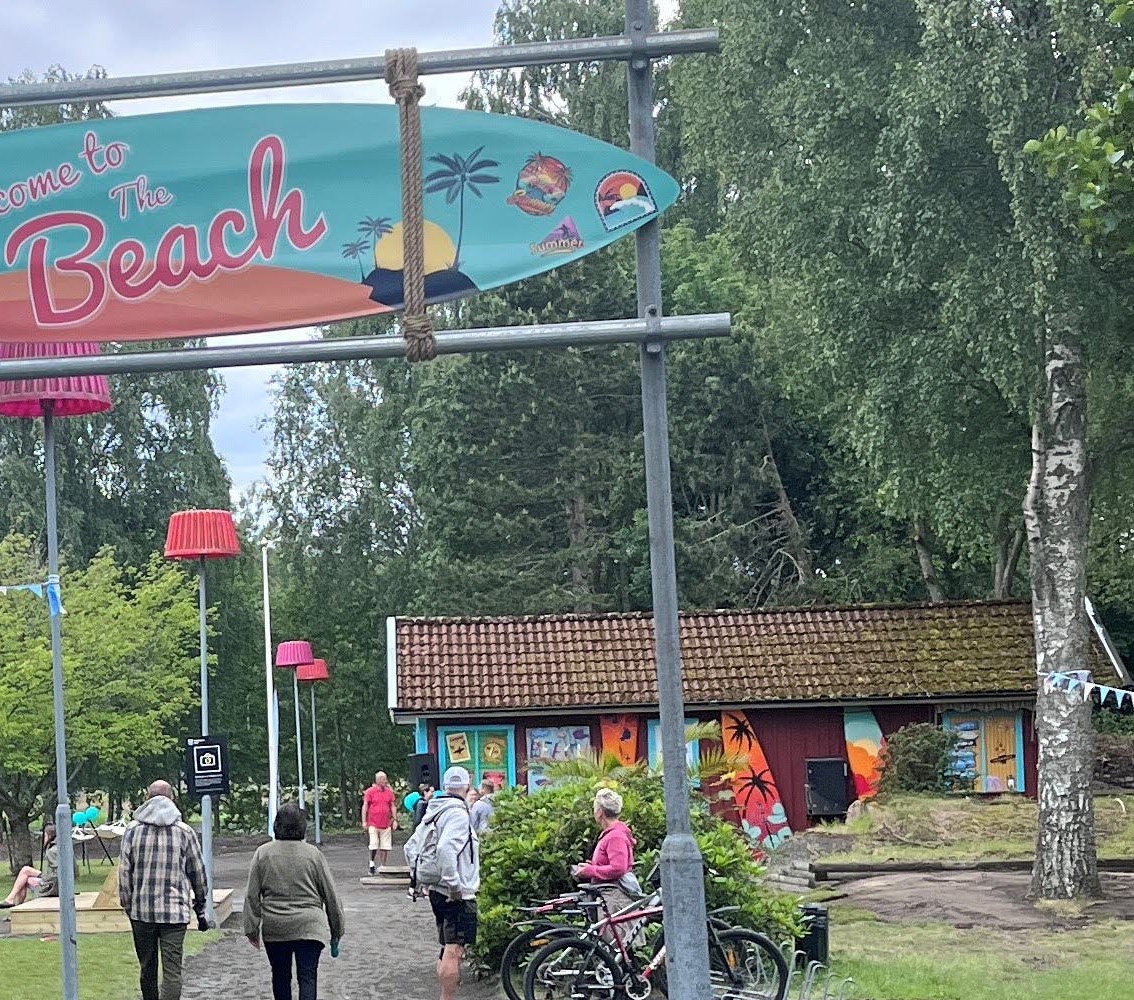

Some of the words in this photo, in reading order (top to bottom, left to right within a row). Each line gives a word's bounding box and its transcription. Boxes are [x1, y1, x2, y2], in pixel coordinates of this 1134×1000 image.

[78, 131, 130, 175] to
[109, 174, 173, 219] The
[4, 134, 328, 327] Beach
[529, 238, 584, 255] Summer
